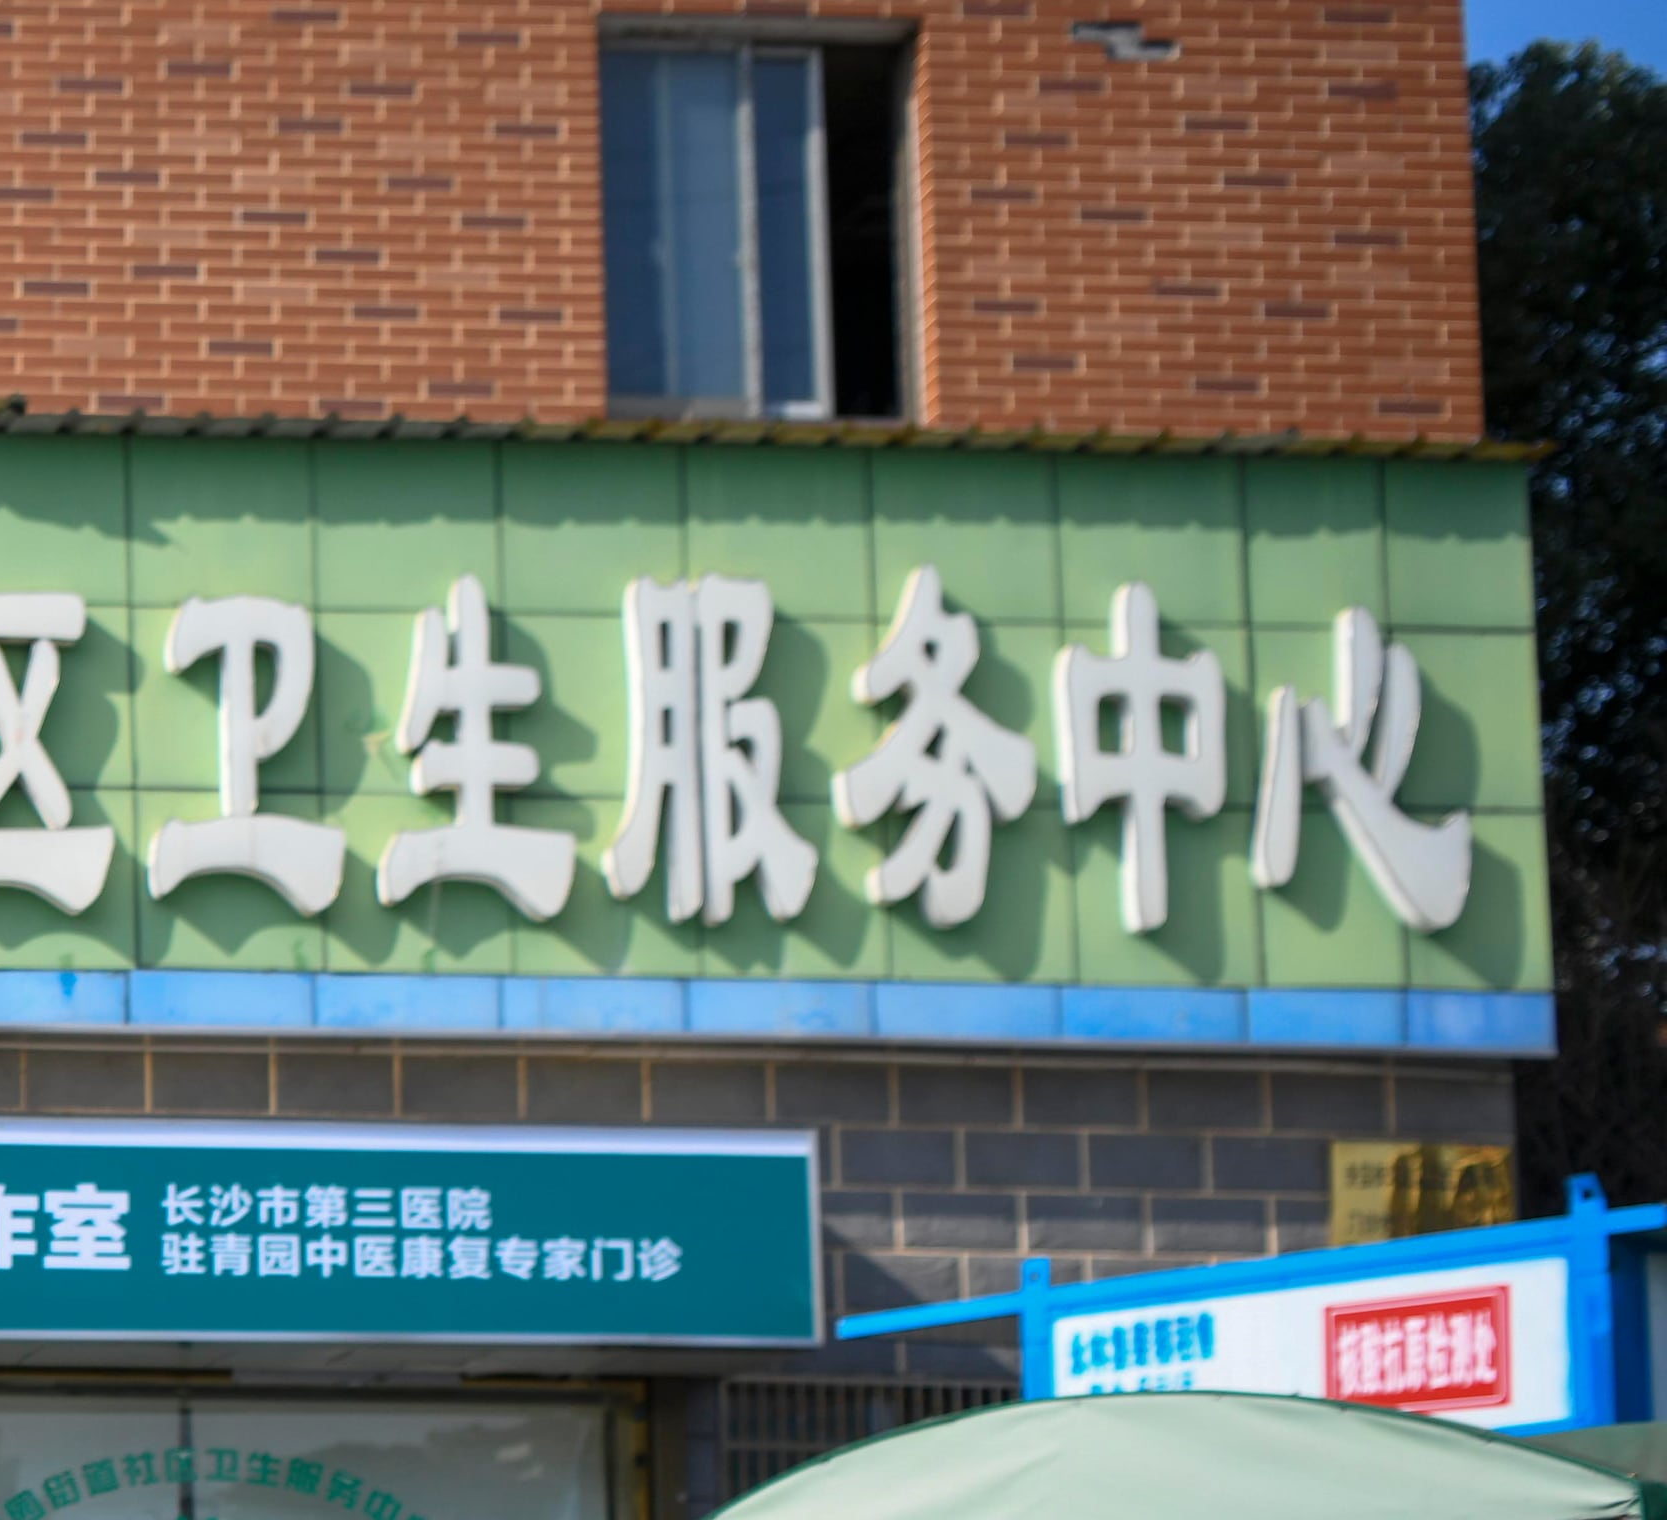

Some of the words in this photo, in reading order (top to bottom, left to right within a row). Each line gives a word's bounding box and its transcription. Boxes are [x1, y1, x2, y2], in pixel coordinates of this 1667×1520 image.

[161, 1183, 493, 1231] 长沙市第三医院
[161, 1232, 683, 1281] 驻青园中医康复专家门诊
